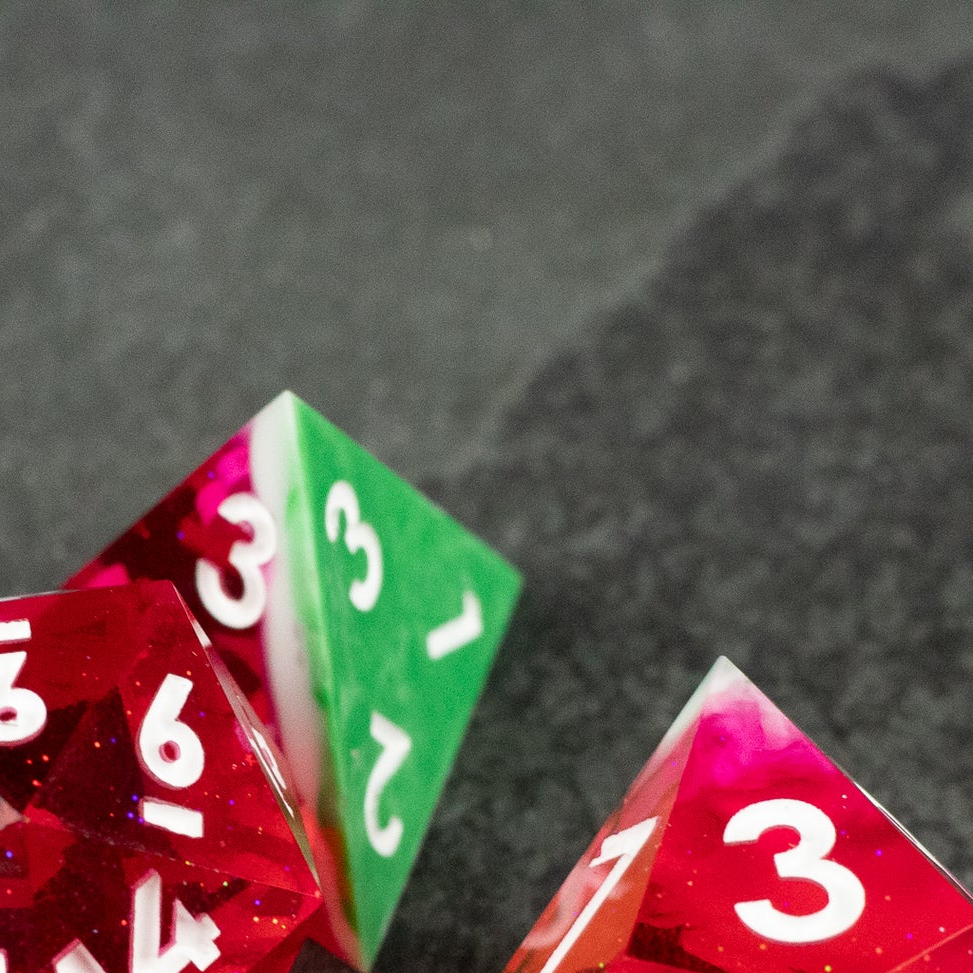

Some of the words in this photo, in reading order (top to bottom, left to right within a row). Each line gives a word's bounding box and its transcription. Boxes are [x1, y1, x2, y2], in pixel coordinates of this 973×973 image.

[196, 492, 277, 630] 3
[325, 480, 384, 612] 3
[426, 590, 484, 661] 1
[364, 710, 412, 857] 2
[723, 798, 865, 944] 3
